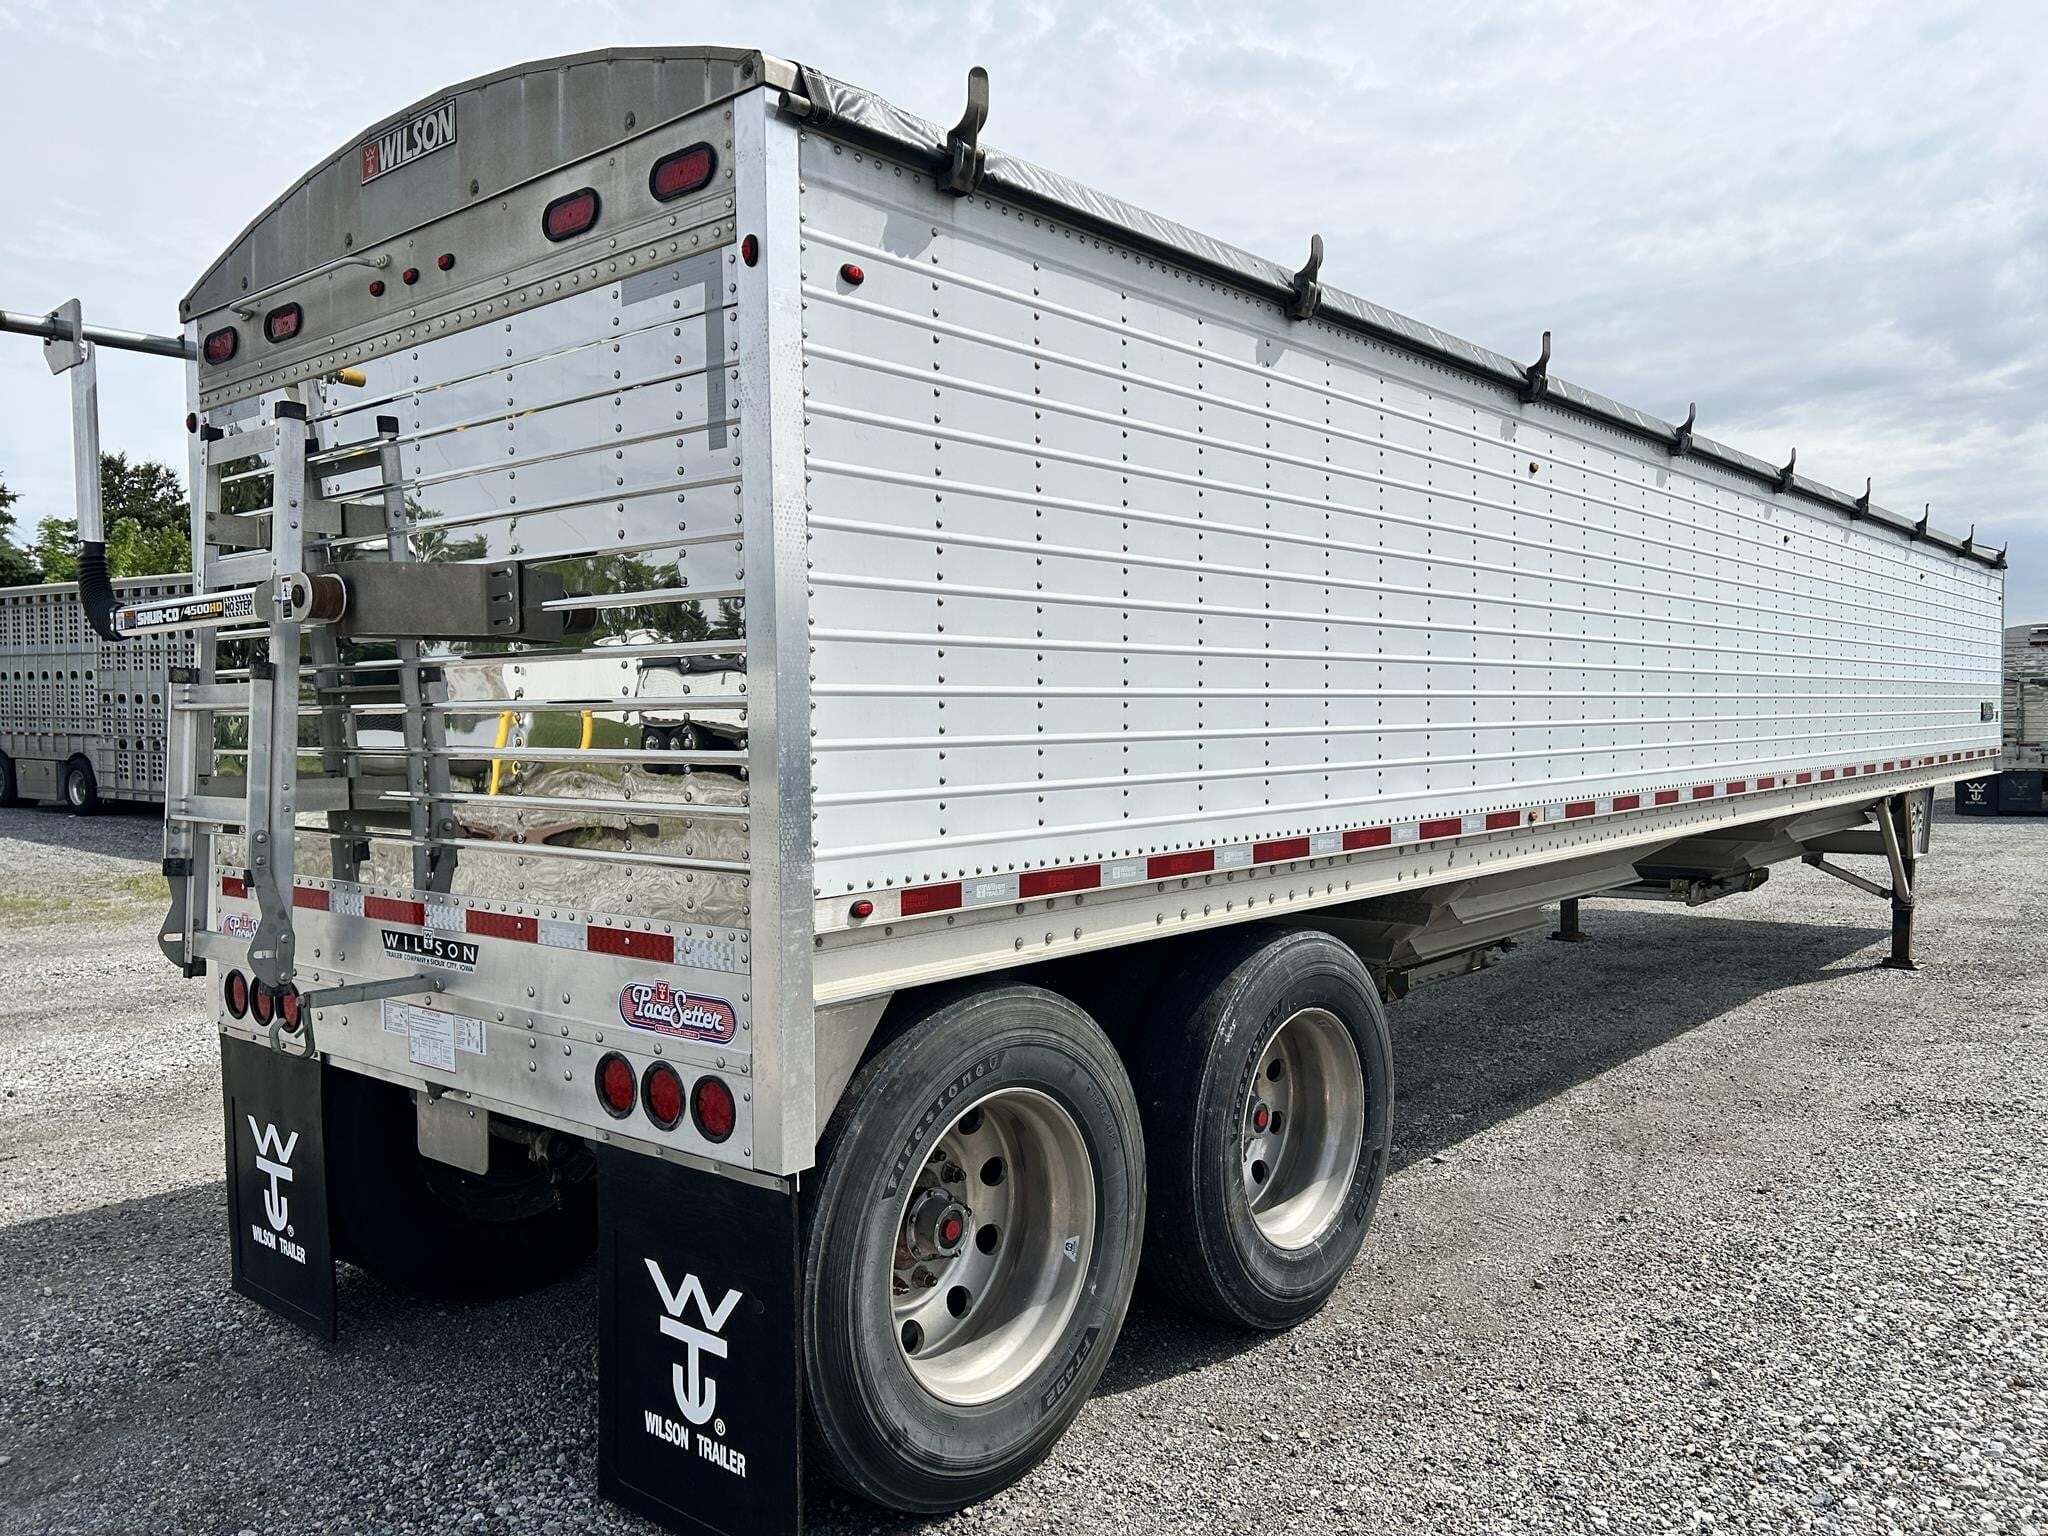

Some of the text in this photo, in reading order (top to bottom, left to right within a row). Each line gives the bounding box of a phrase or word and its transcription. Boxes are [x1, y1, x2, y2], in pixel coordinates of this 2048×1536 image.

[378, 105, 453, 172] WILSON
[137, 608, 180, 626] SHUR-CO
[225, 599, 252, 612] NO STEP
[383, 931, 476, 962] WILSON
[385, 950, 403, 960] TRAILER
[403, 953, 426, 964] COMPANY
[430, 958, 445, 967] SIOUX
[459, 963, 474, 973] IOWA
[252, 1224, 306, 1265] WILSON TRAILER
[644, 1410, 746, 1478] WILSON TRAILER
